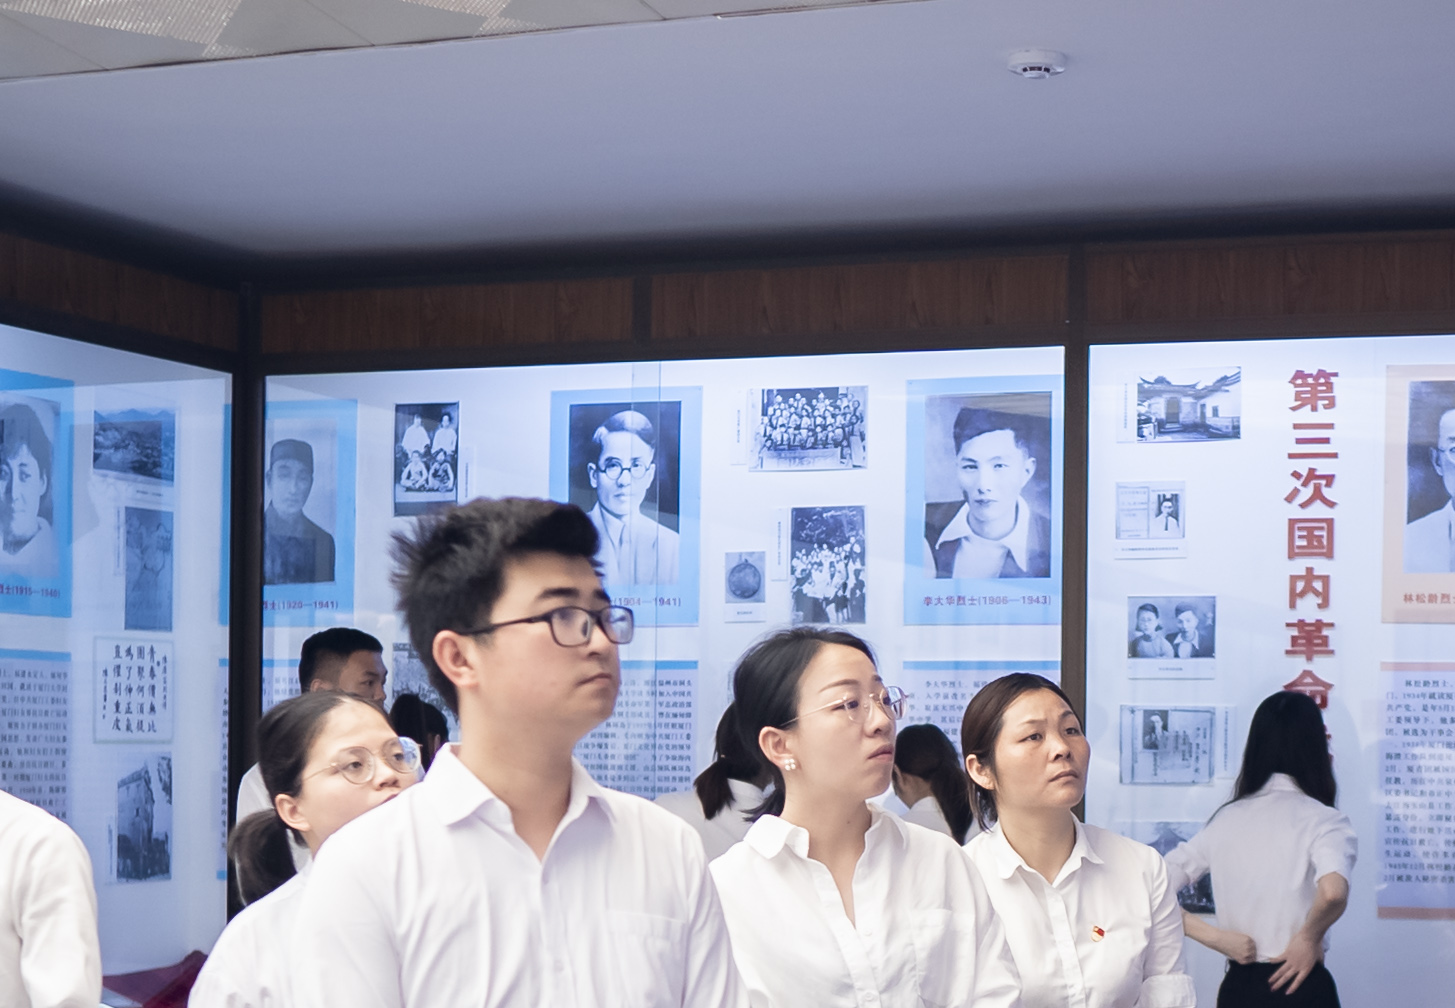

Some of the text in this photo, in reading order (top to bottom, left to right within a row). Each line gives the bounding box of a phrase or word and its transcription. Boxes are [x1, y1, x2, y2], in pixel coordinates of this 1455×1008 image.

[1283, 369, 1339, 709] 第三次国内革命
